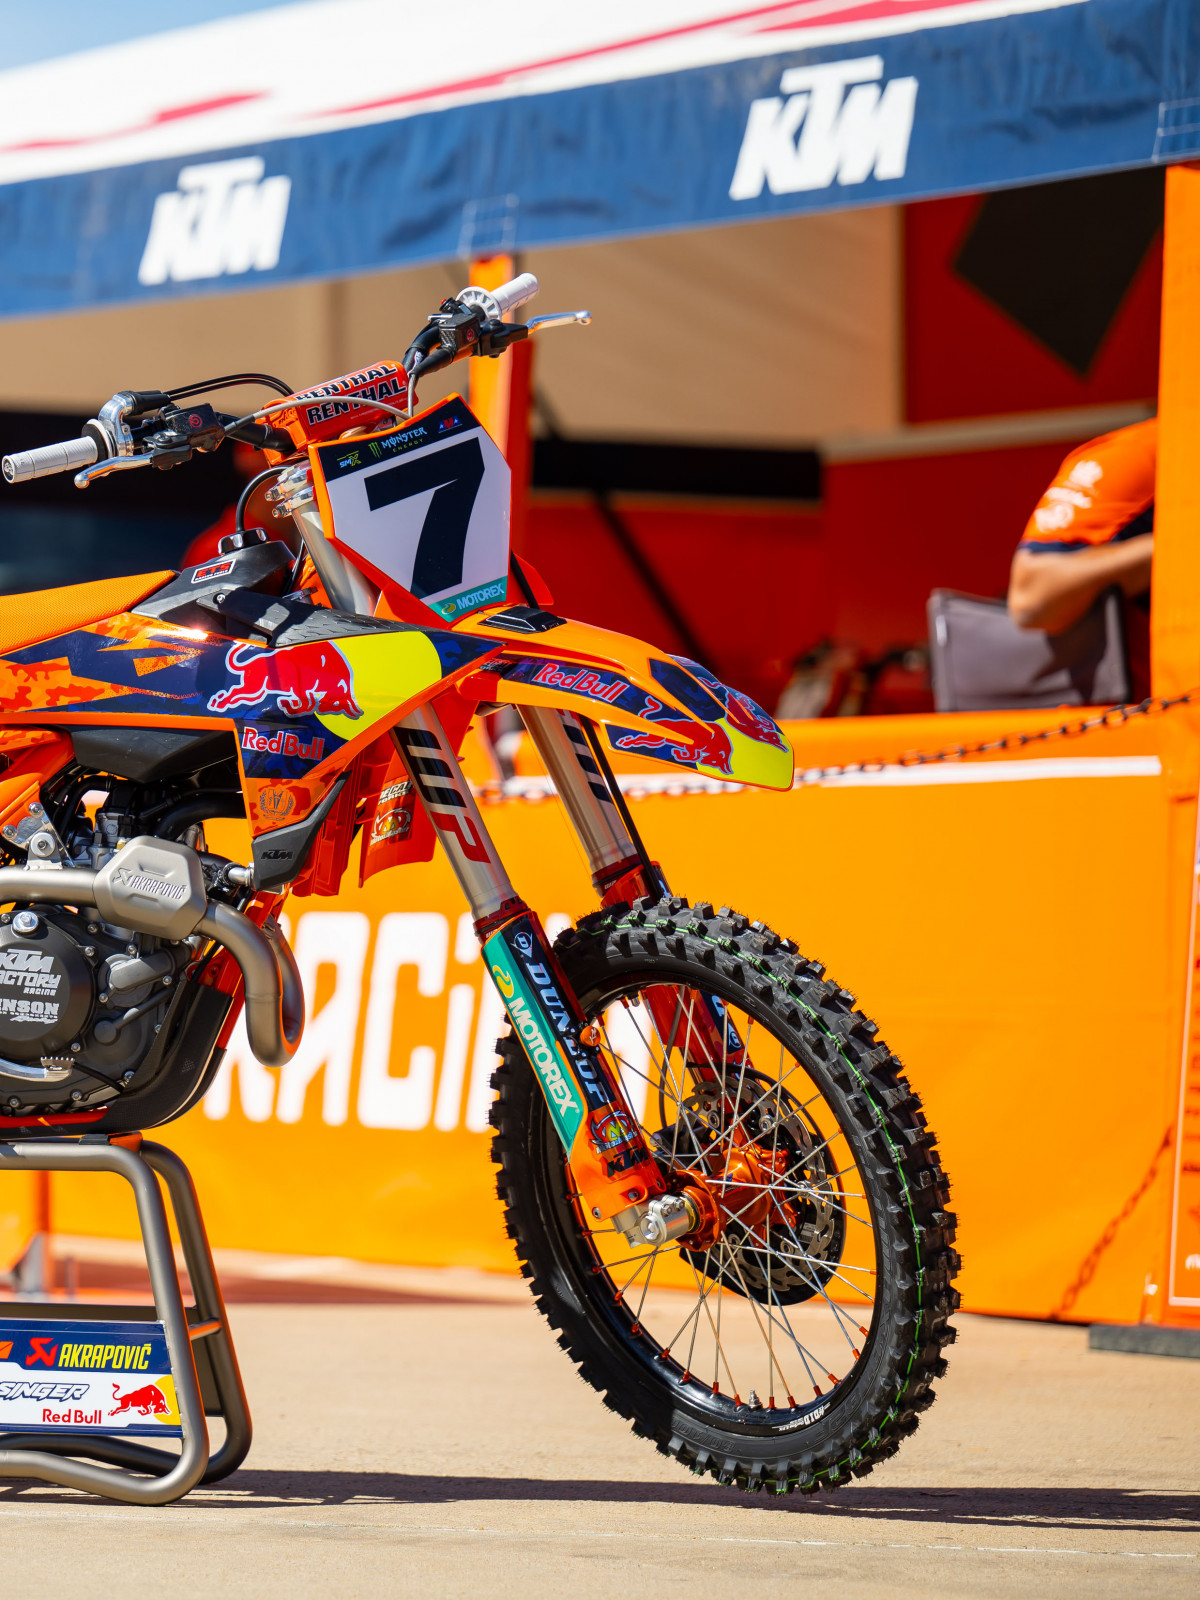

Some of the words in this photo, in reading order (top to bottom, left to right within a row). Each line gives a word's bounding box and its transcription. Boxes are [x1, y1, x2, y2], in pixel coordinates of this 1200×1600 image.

[729, 55, 919, 201] KTM
[139, 156, 291, 286] KTM
[306, 376, 406, 425] RENTHAL
[381, 426, 428, 449] MONSTER
[392, 438, 423, 453] ENERGY
[364, 437, 485, 599] 7
[196, 562, 231, 577] ETS
[456, 582, 505, 610] MOTOREX
[532, 662, 588, 689] Red
[572, 671, 630, 704] Bull
[242, 726, 283, 753] Red
[283, 731, 326, 761] Bull
[261, 849, 293, 862] KTM
[23, 986, 57, 996] RACING
[508, 996, 576, 1118] MOTOREX
[607, 1145, 648, 1178] KTM
[58, 1343, 152, 1370] AKRAPOVIČ
[42, 1408, 71, 1423] Red
[73, 1409, 102, 1424] Bull
